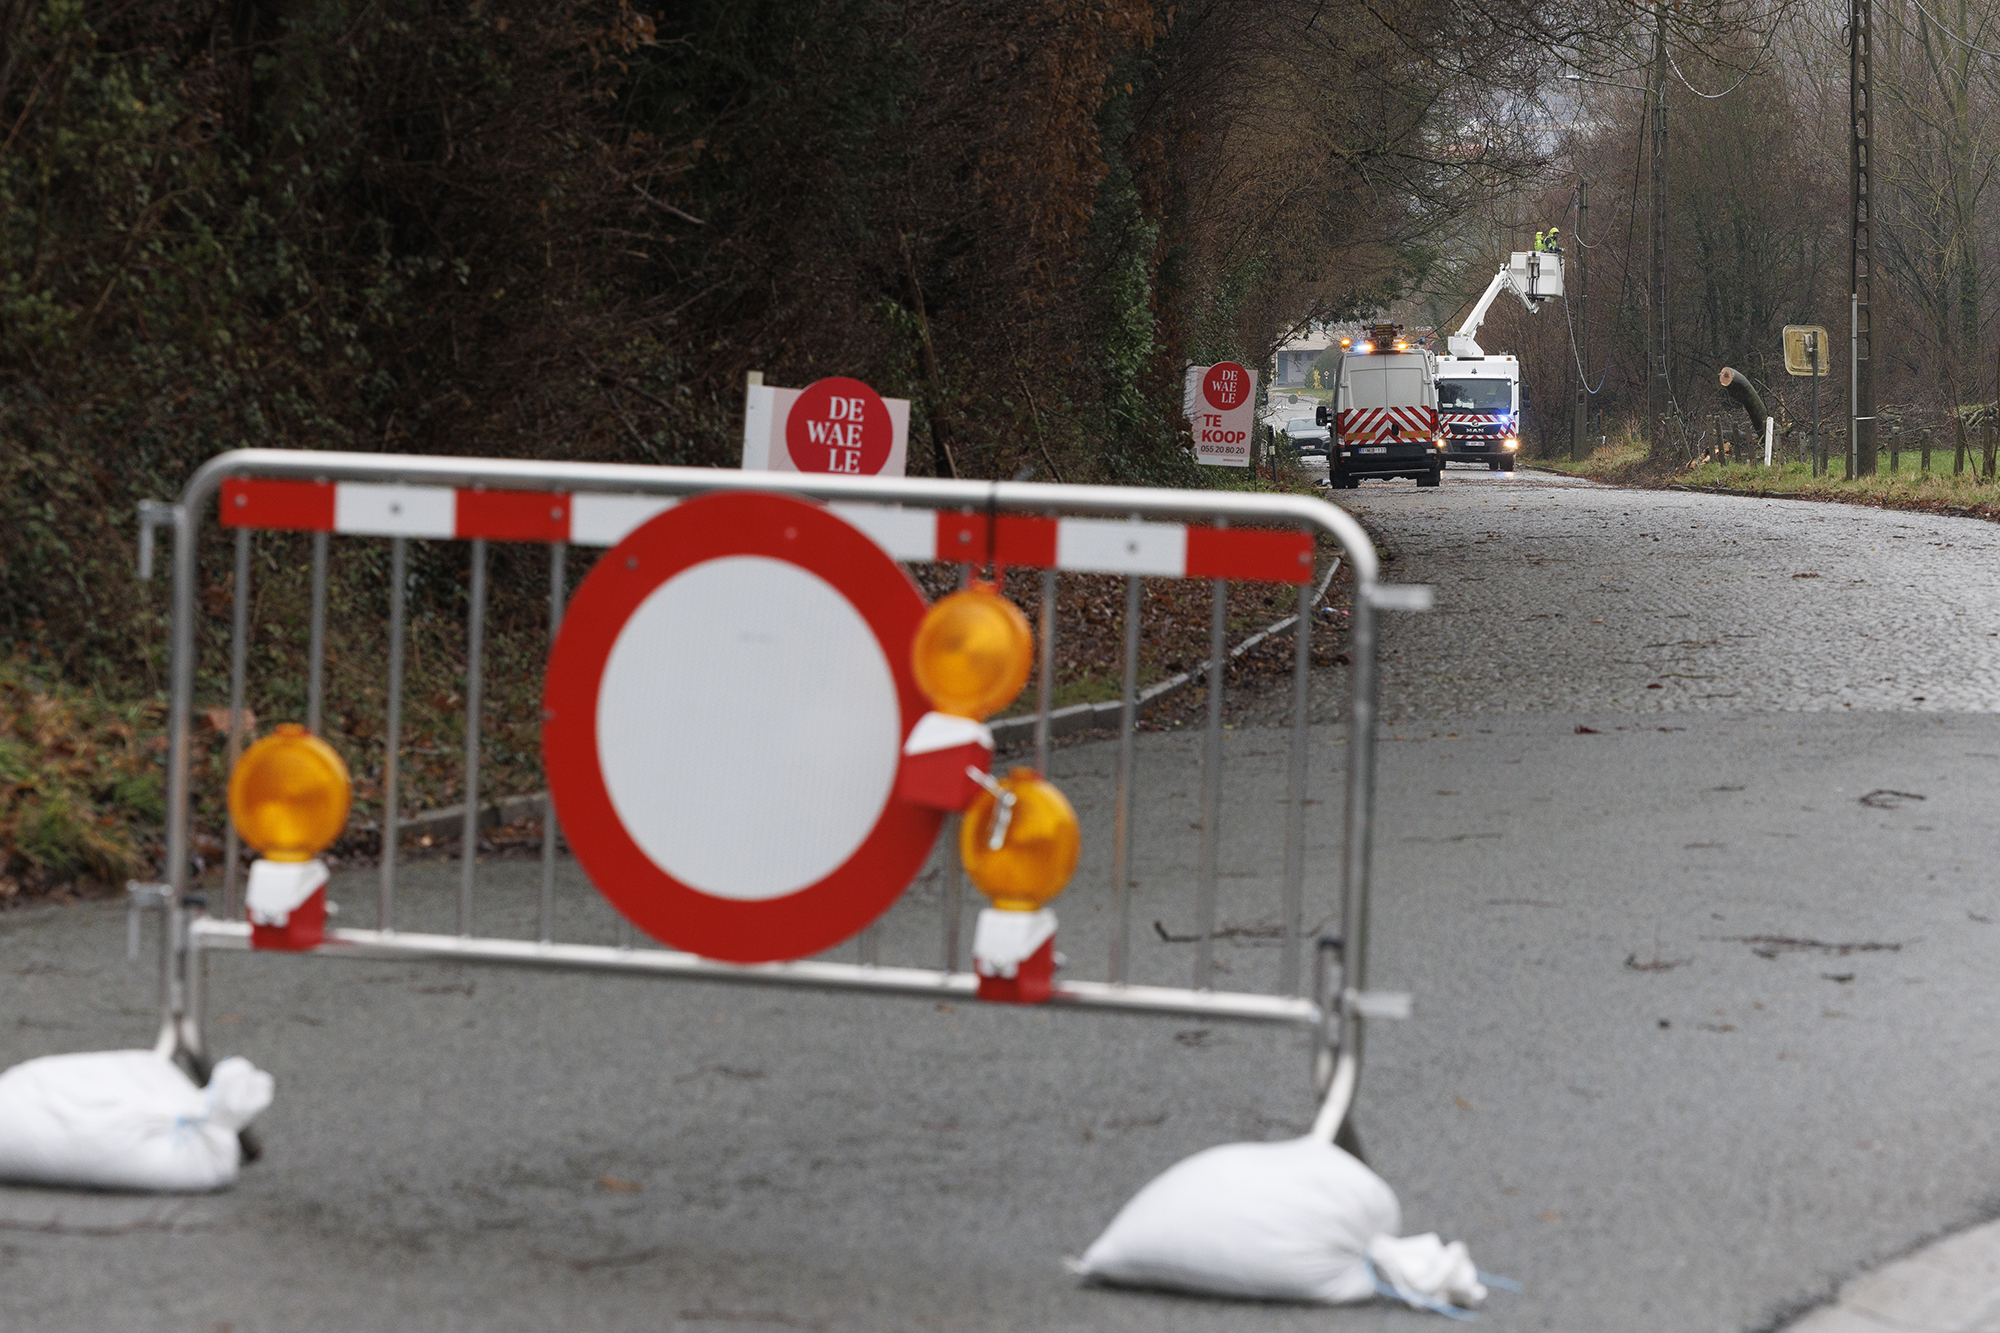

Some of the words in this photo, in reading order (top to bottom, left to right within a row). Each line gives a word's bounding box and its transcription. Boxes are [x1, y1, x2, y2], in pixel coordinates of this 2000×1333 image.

[1222, 370, 1238, 381] DE
[1212, 381, 1237, 392] WAE
[1221, 393, 1236, 404] LE
[829, 396, 865, 422] DE
[1203, 414, 1222, 427] TE
[806, 420, 863, 448] WAE
[1201, 430, 1246, 444] KOOP
[1200, 445, 1214, 453] 055
[1225, 446, 1235, 454] 80
[1236, 446, 1245, 454] 20
[828, 448, 861, 474] LE
